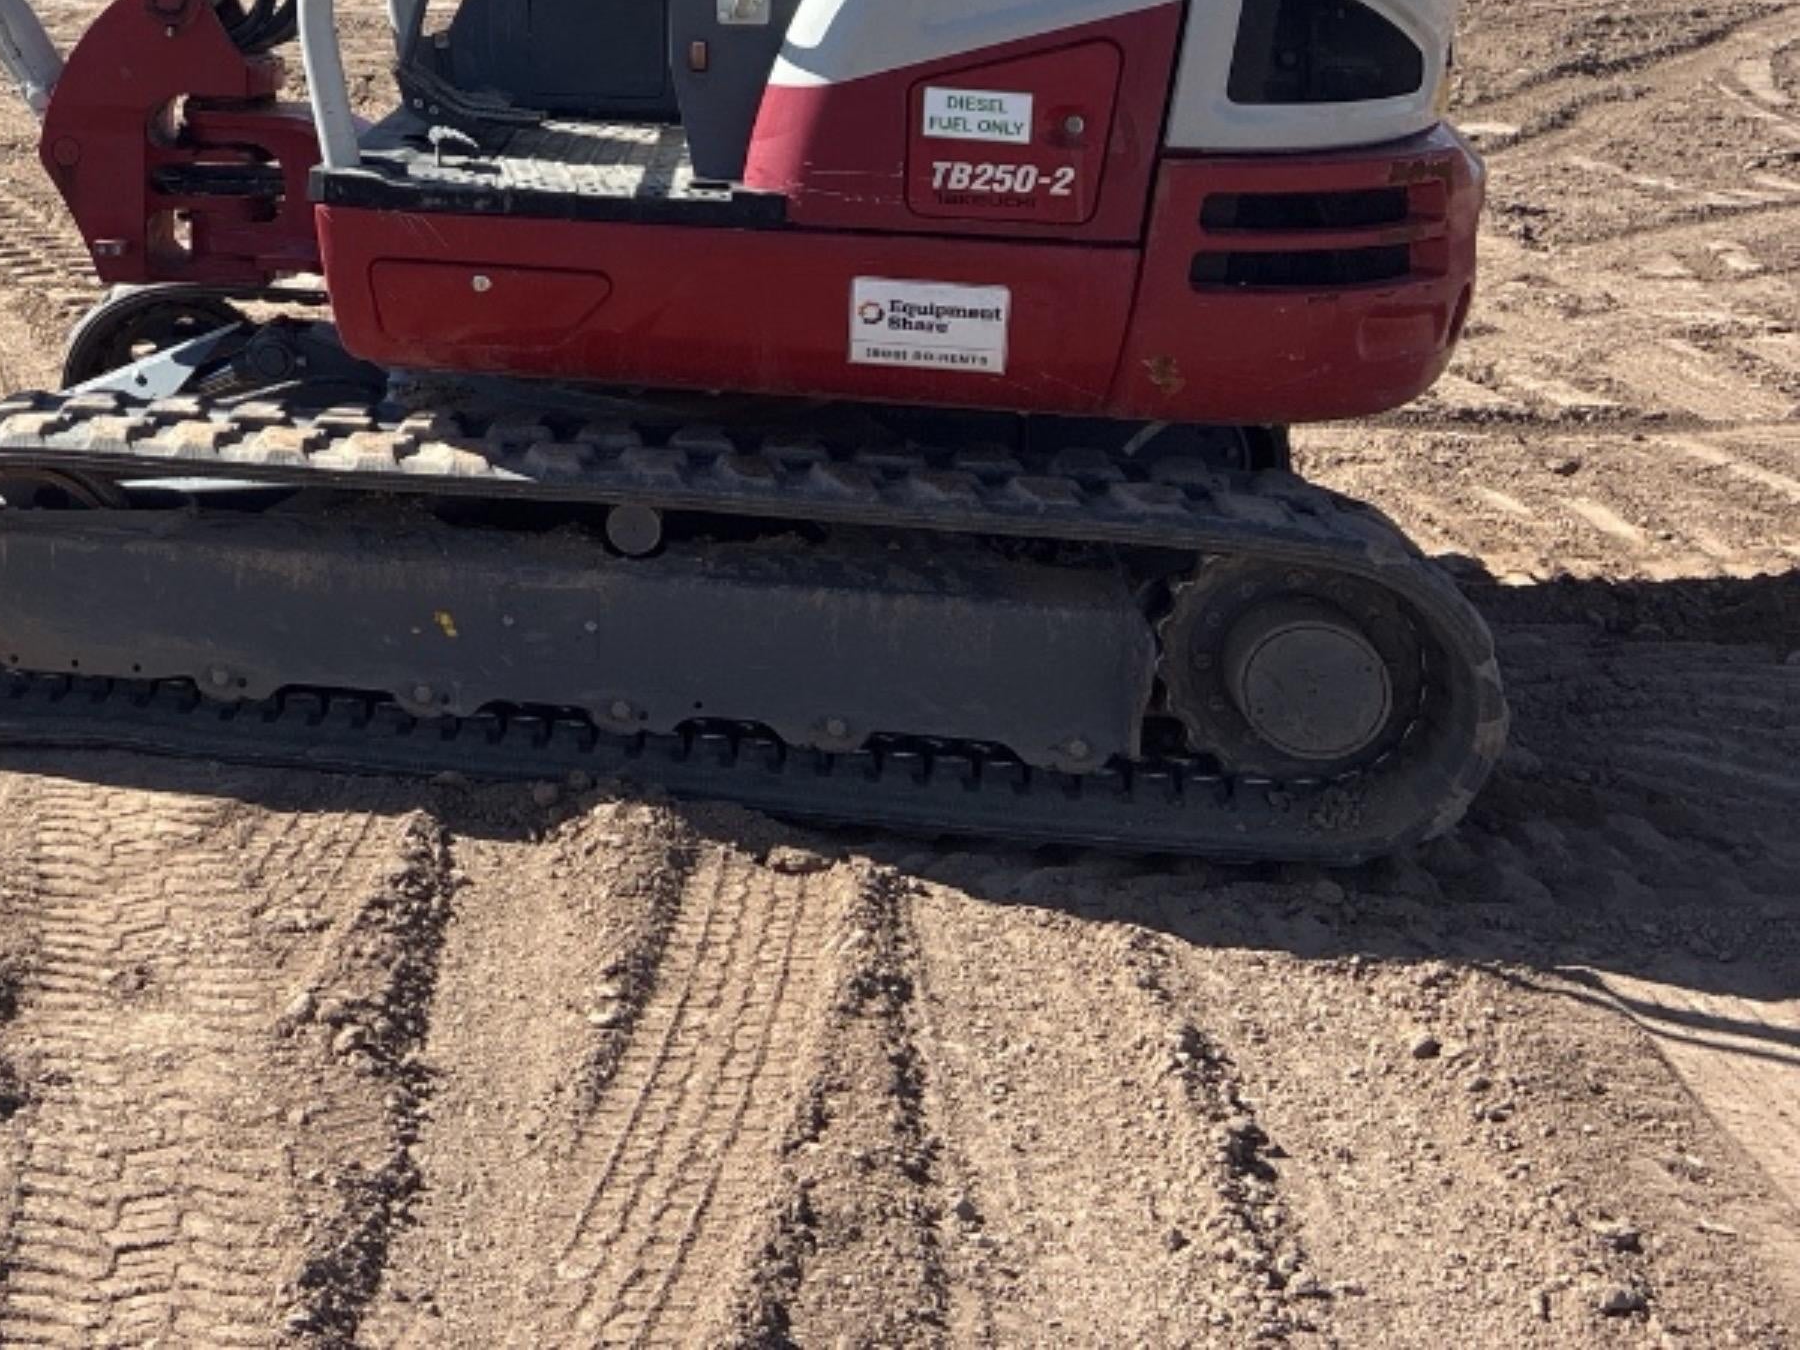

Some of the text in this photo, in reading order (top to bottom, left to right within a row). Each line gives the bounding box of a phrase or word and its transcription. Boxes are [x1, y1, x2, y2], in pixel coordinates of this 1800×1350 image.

[947, 95, 1008, 114] DIESEL
[929, 116, 1025, 136] FUEL ONLY
[932, 161, 1075, 196] TB250-2
[888, 299, 1003, 321] Equipment
[887, 316, 949, 333] Share
